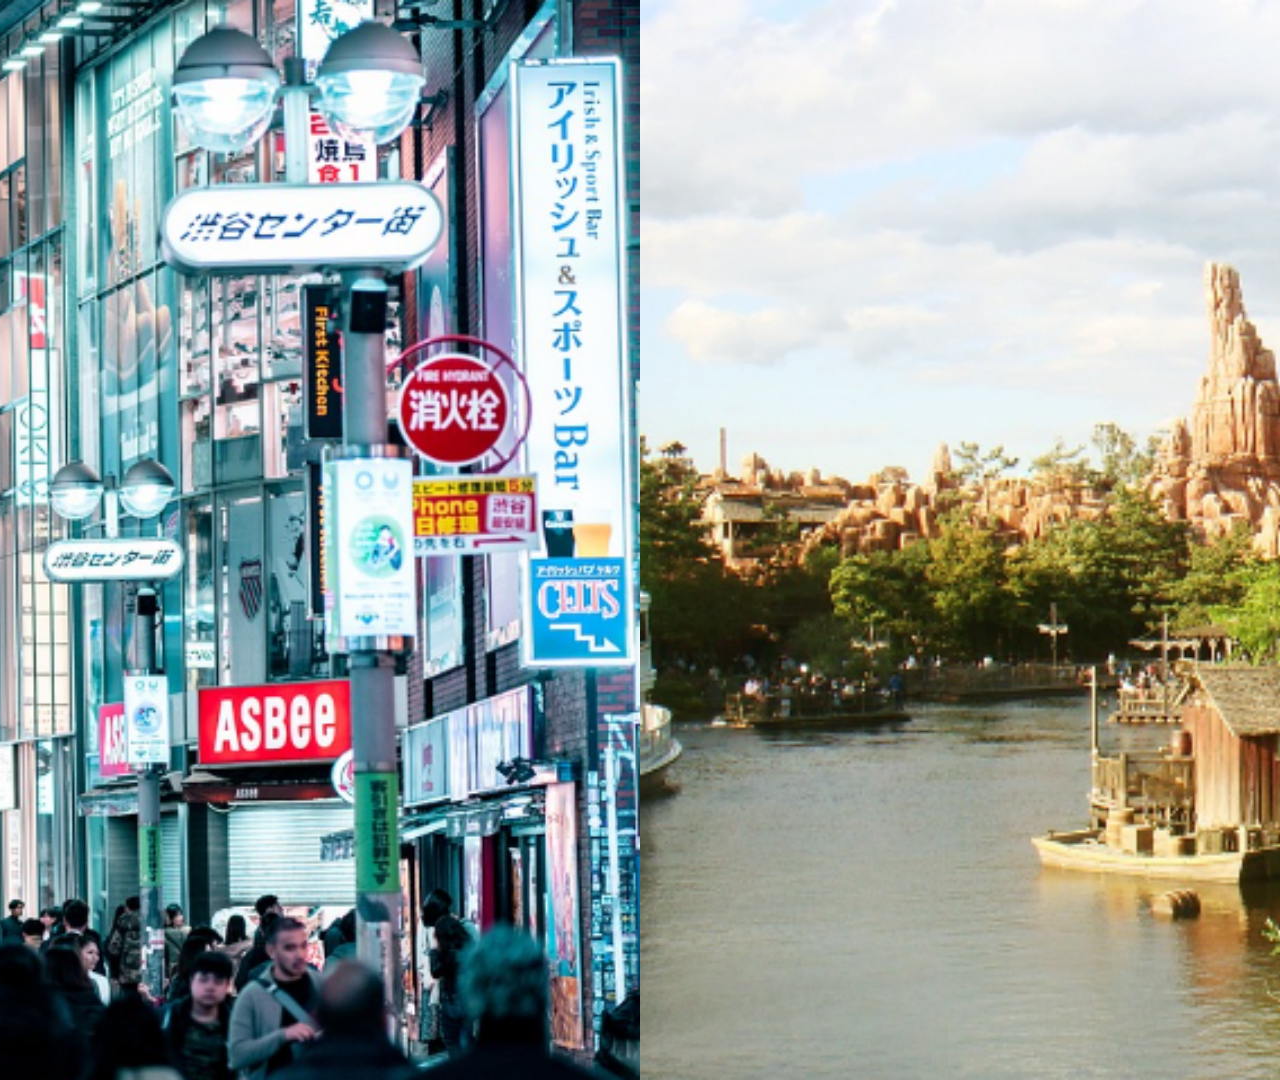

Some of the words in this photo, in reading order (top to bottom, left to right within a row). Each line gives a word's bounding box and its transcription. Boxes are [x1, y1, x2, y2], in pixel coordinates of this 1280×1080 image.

[582, 81, 601, 129] Irish
[584, 134, 599, 145] &
[581, 150, 602, 203] Sport
[180, 206, 426, 242] 渋谷センター街
[586, 208, 603, 240] Bar
[315, 305, 330, 348] First
[315, 350, 331, 416] Kitchen
[418, 369, 440, 383] FIRE
[443, 369, 490, 383] HYDRANT
[408, 388, 501, 431] 消火栓
[554, 423, 589, 491] Bar
[52, 548, 177, 568] 渋谷センター街
[537, 579, 621, 620] CELTS
